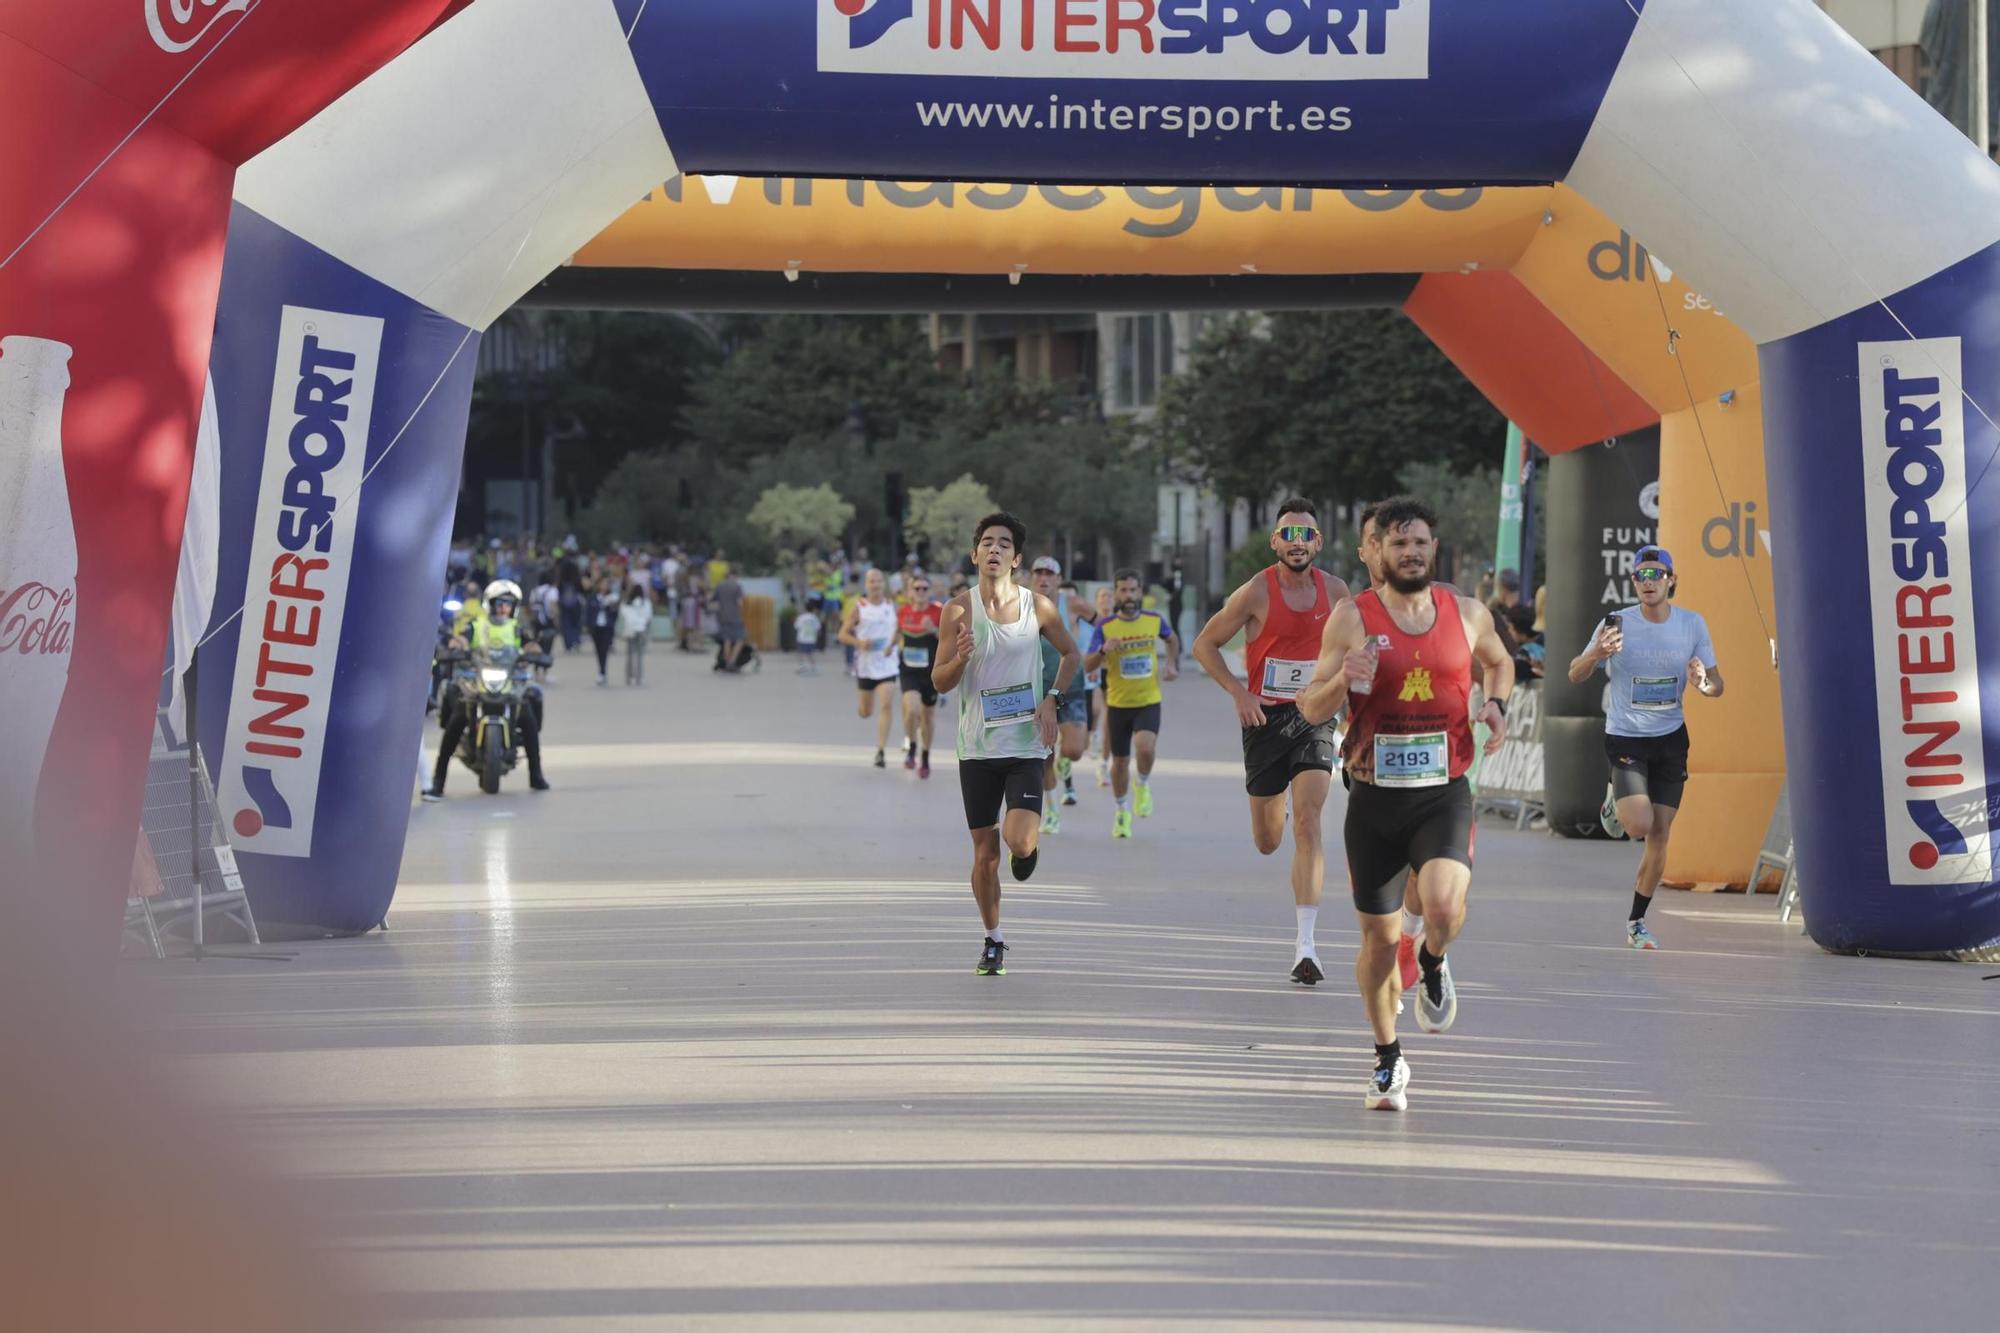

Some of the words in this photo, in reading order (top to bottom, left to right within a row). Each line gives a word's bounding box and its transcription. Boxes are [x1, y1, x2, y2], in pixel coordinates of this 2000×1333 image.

[927, 0, 1400, 55] INTERSPORT
[916, 94, 1353, 138] www.intersport.es
[245, 334, 356, 759] INTERSPORT
[1602, 527, 1660, 545] FUN
[1601, 549, 1636, 577] TR
[1883, 367, 1965, 788] INTERSPORT
[1600, 578, 1641, 605] AL
[1290, 668, 1303, 682] 2
[991, 695, 1022, 711] 3024
[1384, 751, 1431, 767] 2193
